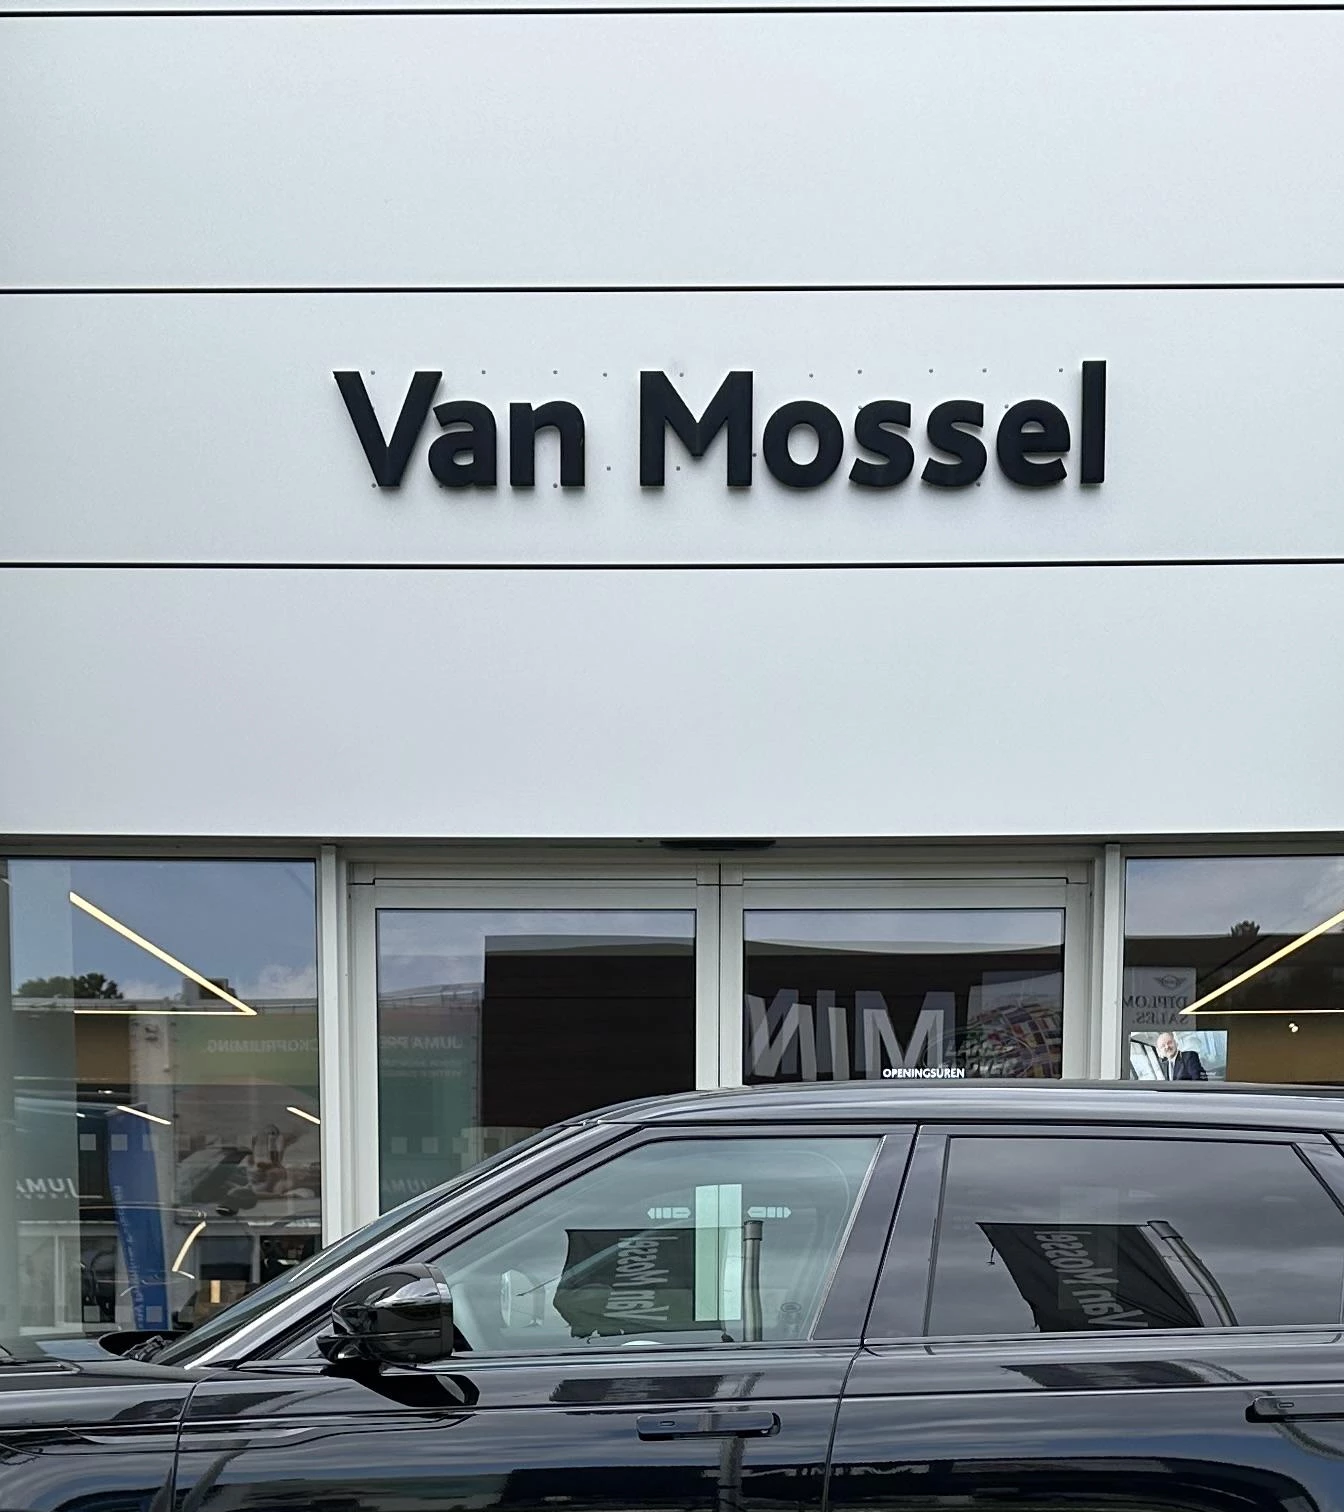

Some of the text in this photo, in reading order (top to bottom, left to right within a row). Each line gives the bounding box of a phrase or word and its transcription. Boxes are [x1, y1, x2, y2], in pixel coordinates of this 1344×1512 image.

[333, 360, 1106, 489] Van Mossel
[883, 1068, 965, 1079] OPENINGSUREN
